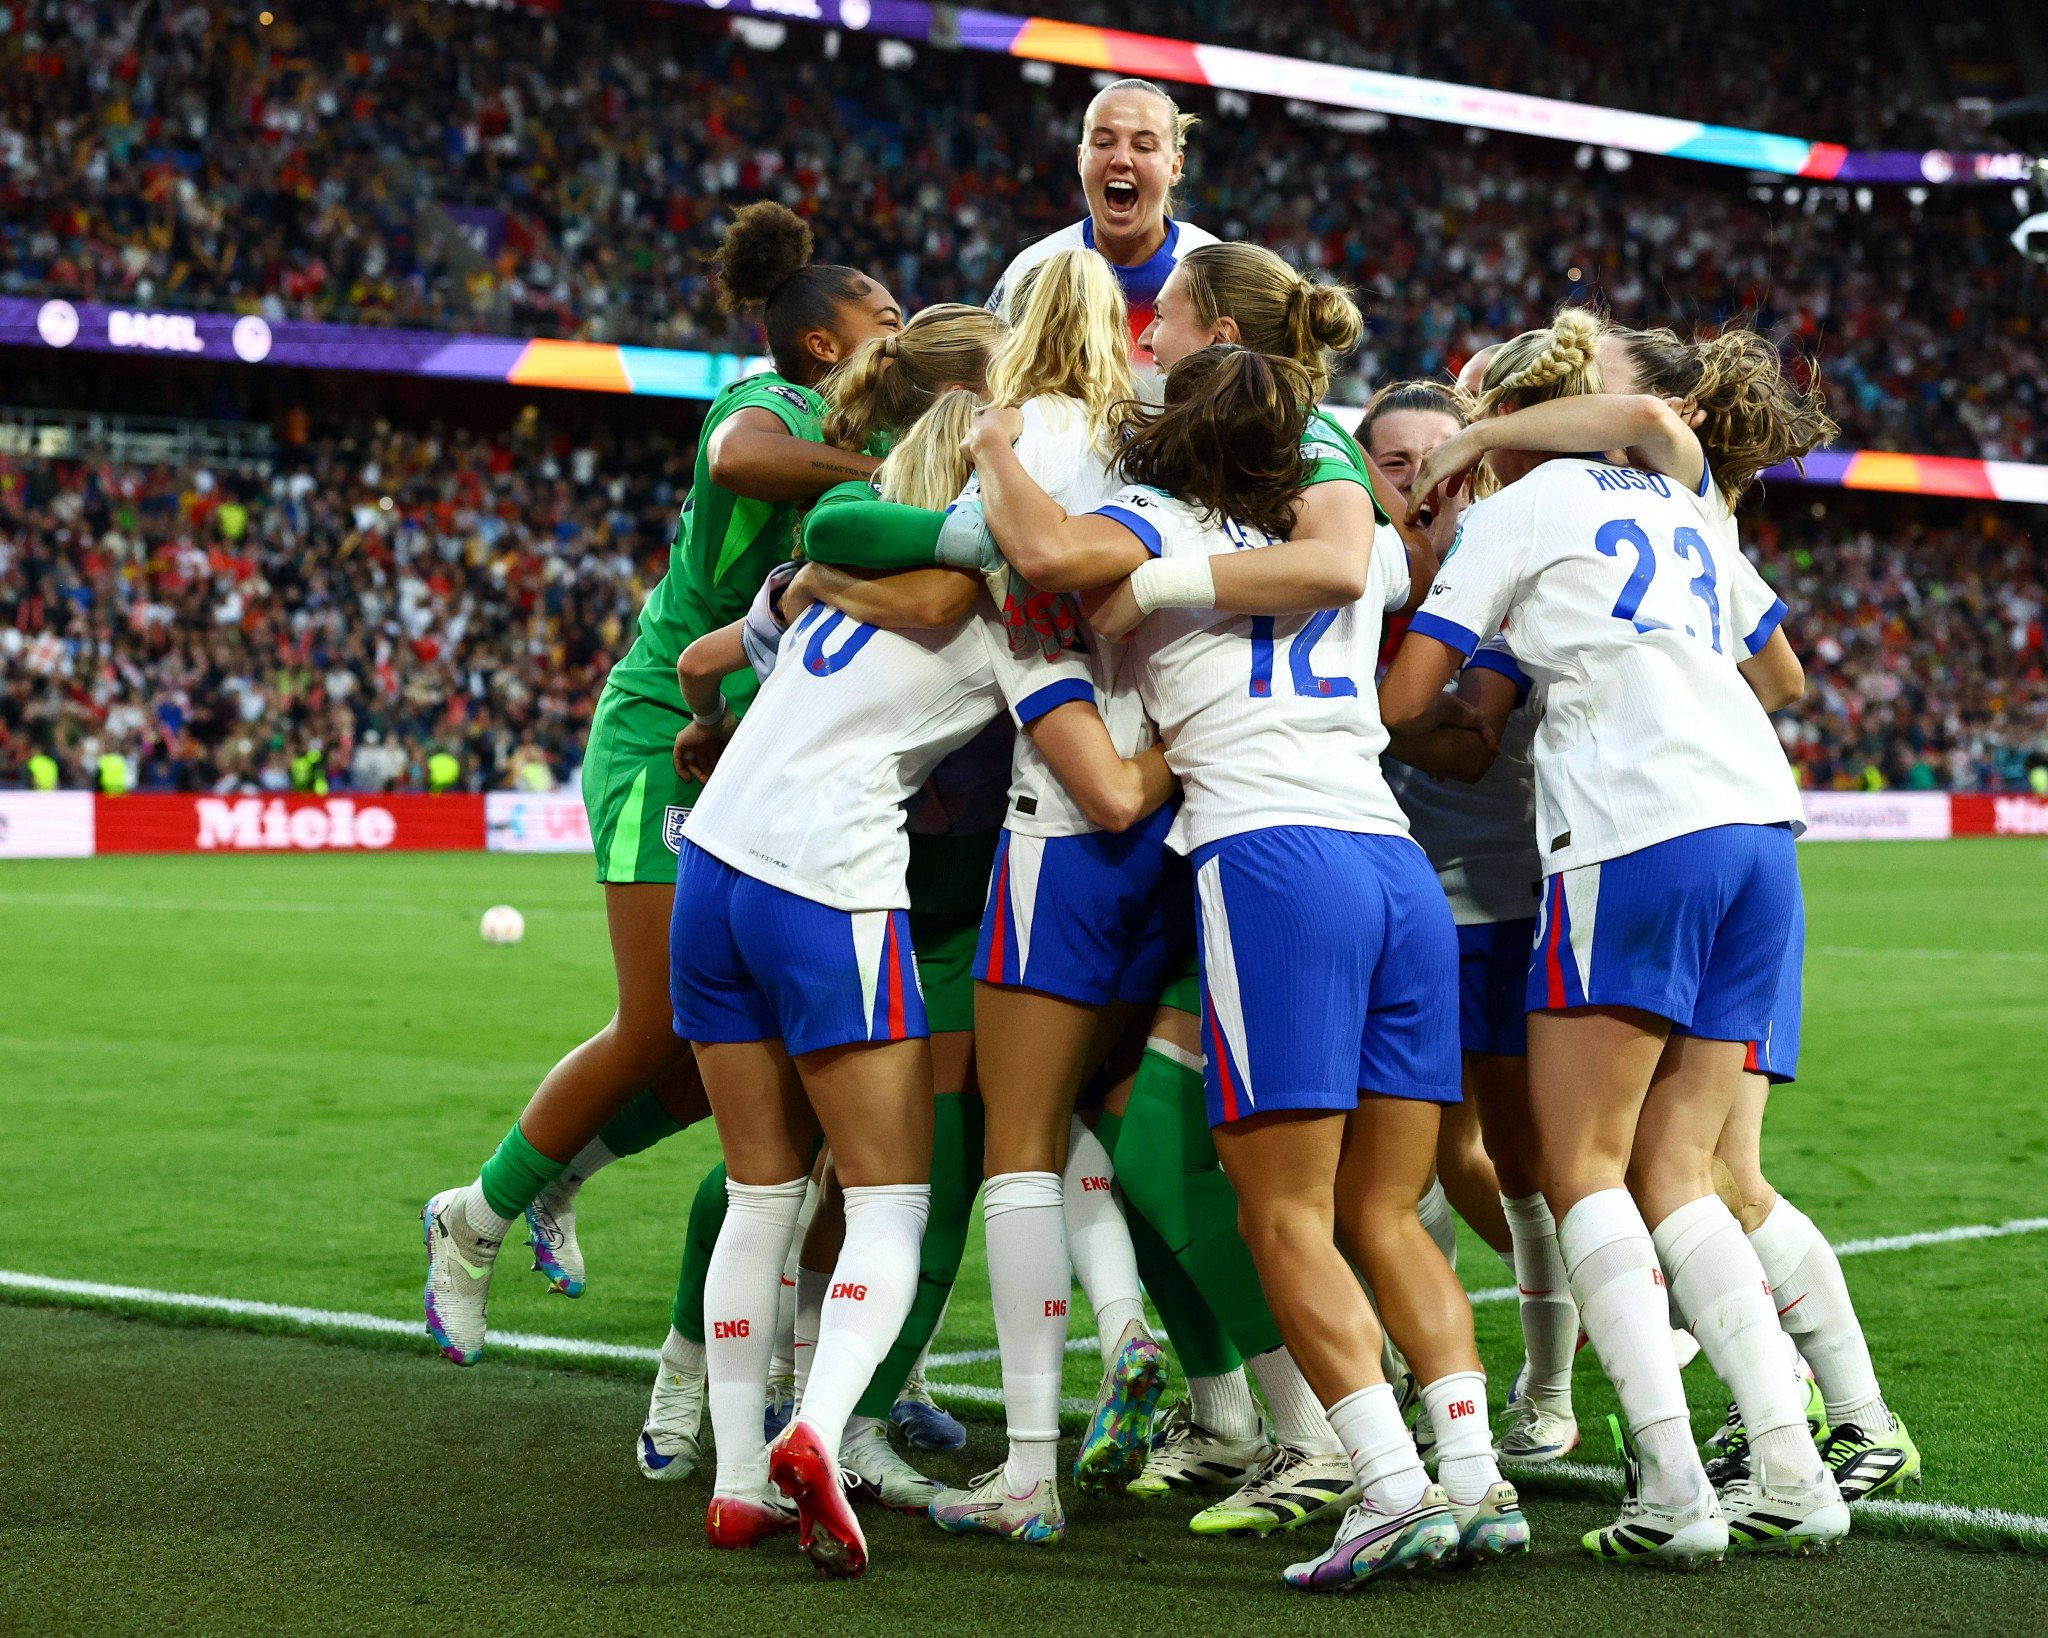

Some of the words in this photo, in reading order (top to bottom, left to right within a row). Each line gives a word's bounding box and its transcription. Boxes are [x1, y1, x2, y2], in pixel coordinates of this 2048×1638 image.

[1594, 518, 1723, 655] 23
[1249, 608, 1358, 698] 12
[195, 798, 397, 848] Miele
[1081, 1176, 1111, 1192] ENG
[831, 1283, 867, 1301] ENG
[1044, 1299, 1066, 1317] ENG
[713, 1319, 750, 1339] ENG
[1448, 1399, 1475, 1420] ENG
